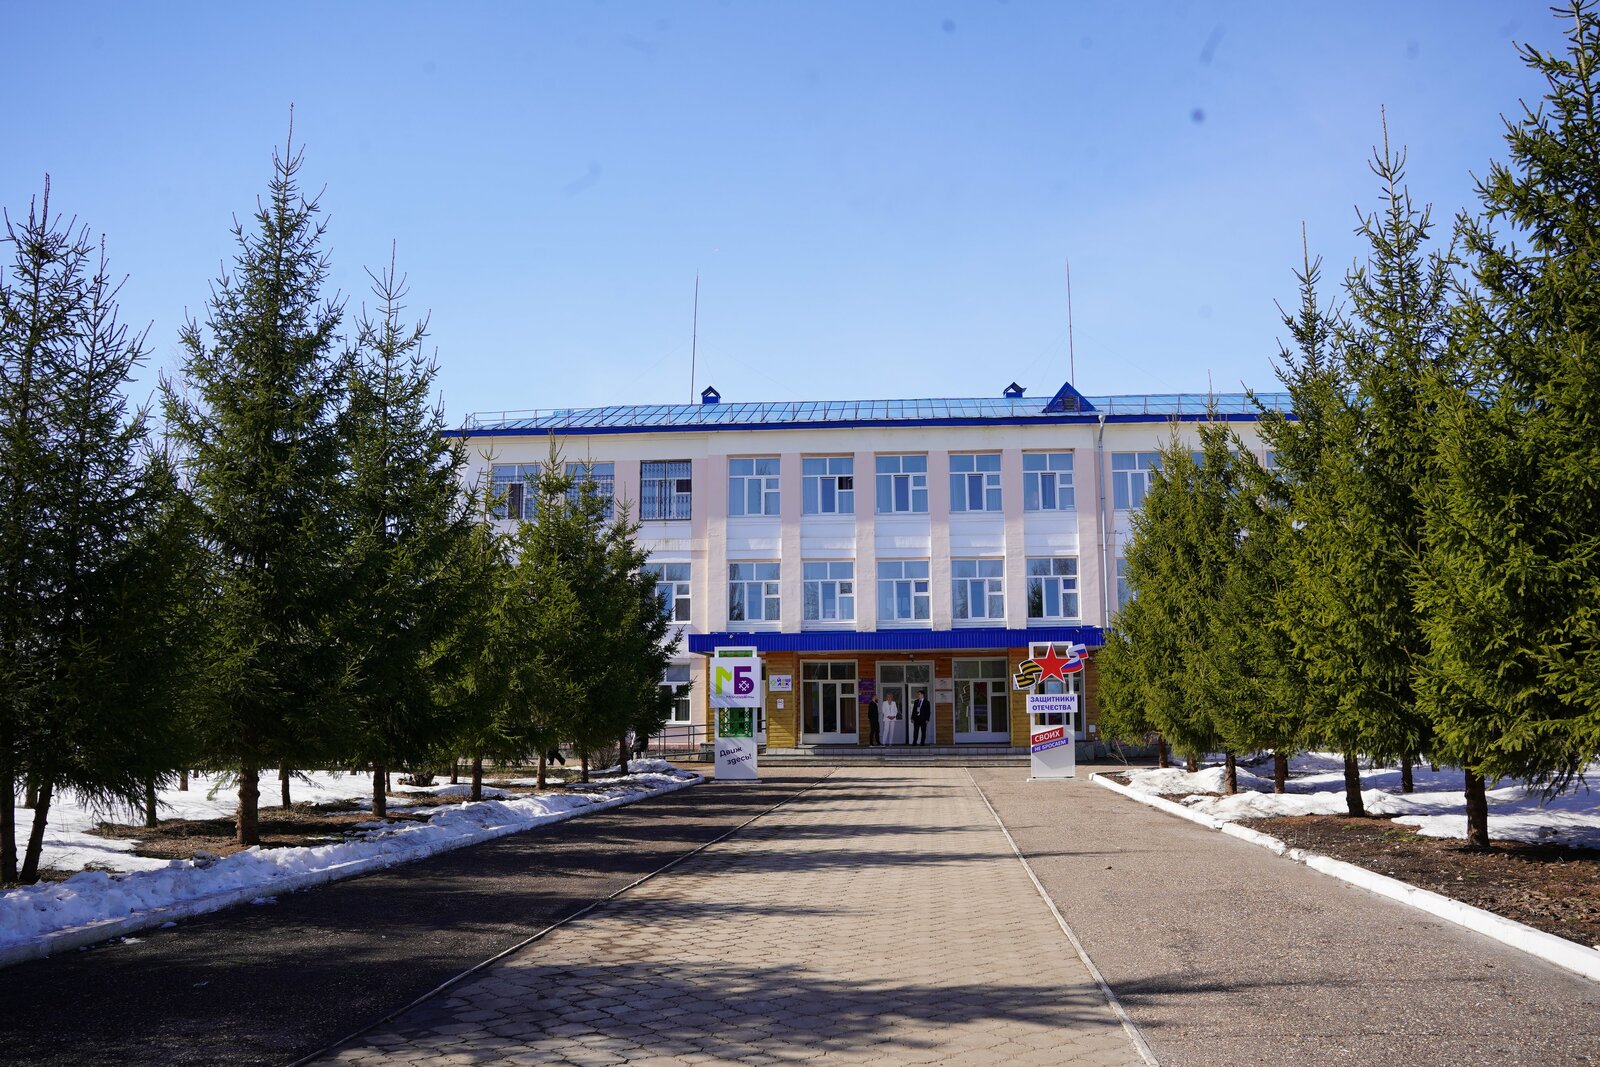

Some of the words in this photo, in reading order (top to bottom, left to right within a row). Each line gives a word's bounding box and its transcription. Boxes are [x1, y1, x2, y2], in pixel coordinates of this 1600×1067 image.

[1035, 730, 1060, 742] СВОИХ
[720, 747, 742, 757] Движ
[727, 753, 752, 765] здесь!
